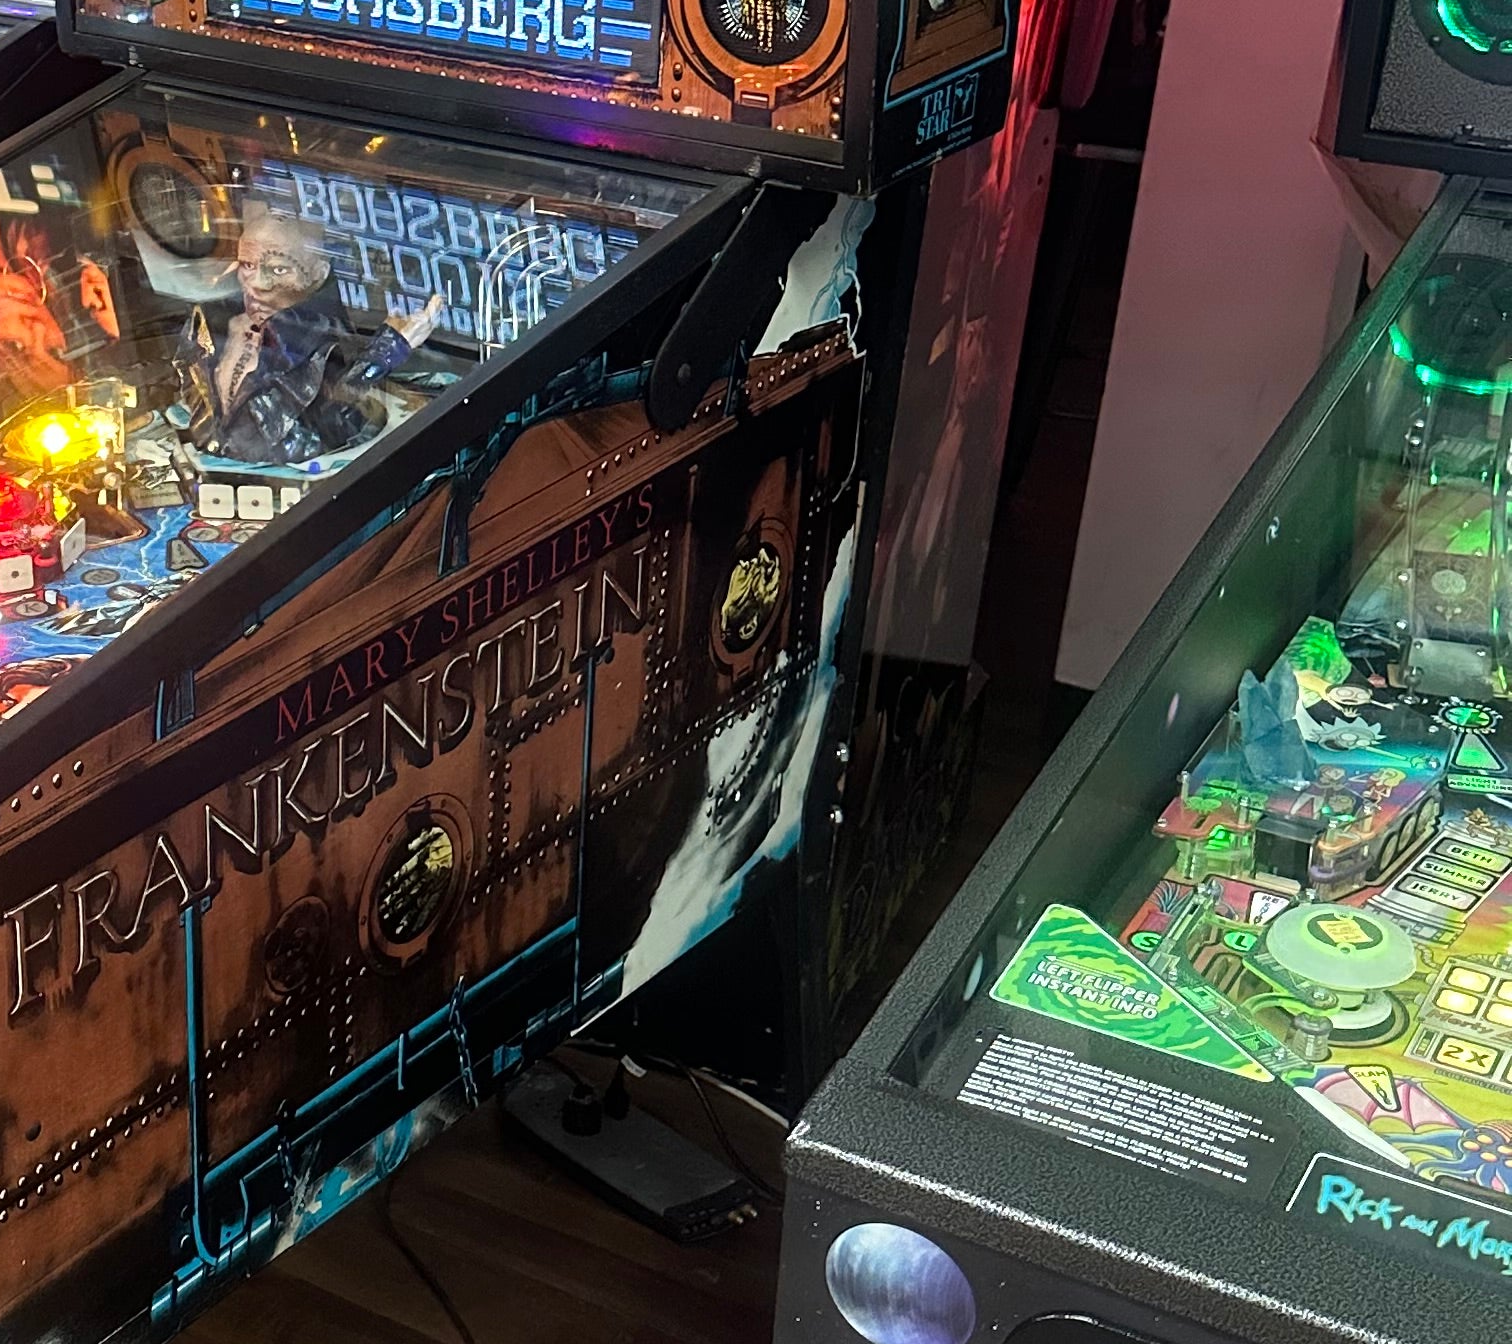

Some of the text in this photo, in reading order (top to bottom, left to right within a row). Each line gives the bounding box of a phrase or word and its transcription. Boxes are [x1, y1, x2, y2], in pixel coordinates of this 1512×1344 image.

[921, 84, 953, 119] TRI
[915, 109, 951, 146] STAR
[273, 483, 656, 743] MARY SHELLEY'S
[4, 549, 652, 1018] FRANKENSTEIN
[1423, 861, 1487, 887] SUMMER
[1450, 845, 1494, 865] BETH
[1410, 881, 1464, 902] JERRY
[1027, 972, 1159, 1021] INSTANT INFO
[1037, 959, 1162, 1007] LEFT FLIPPER
[1316, 1173, 1405, 1231] Rick
